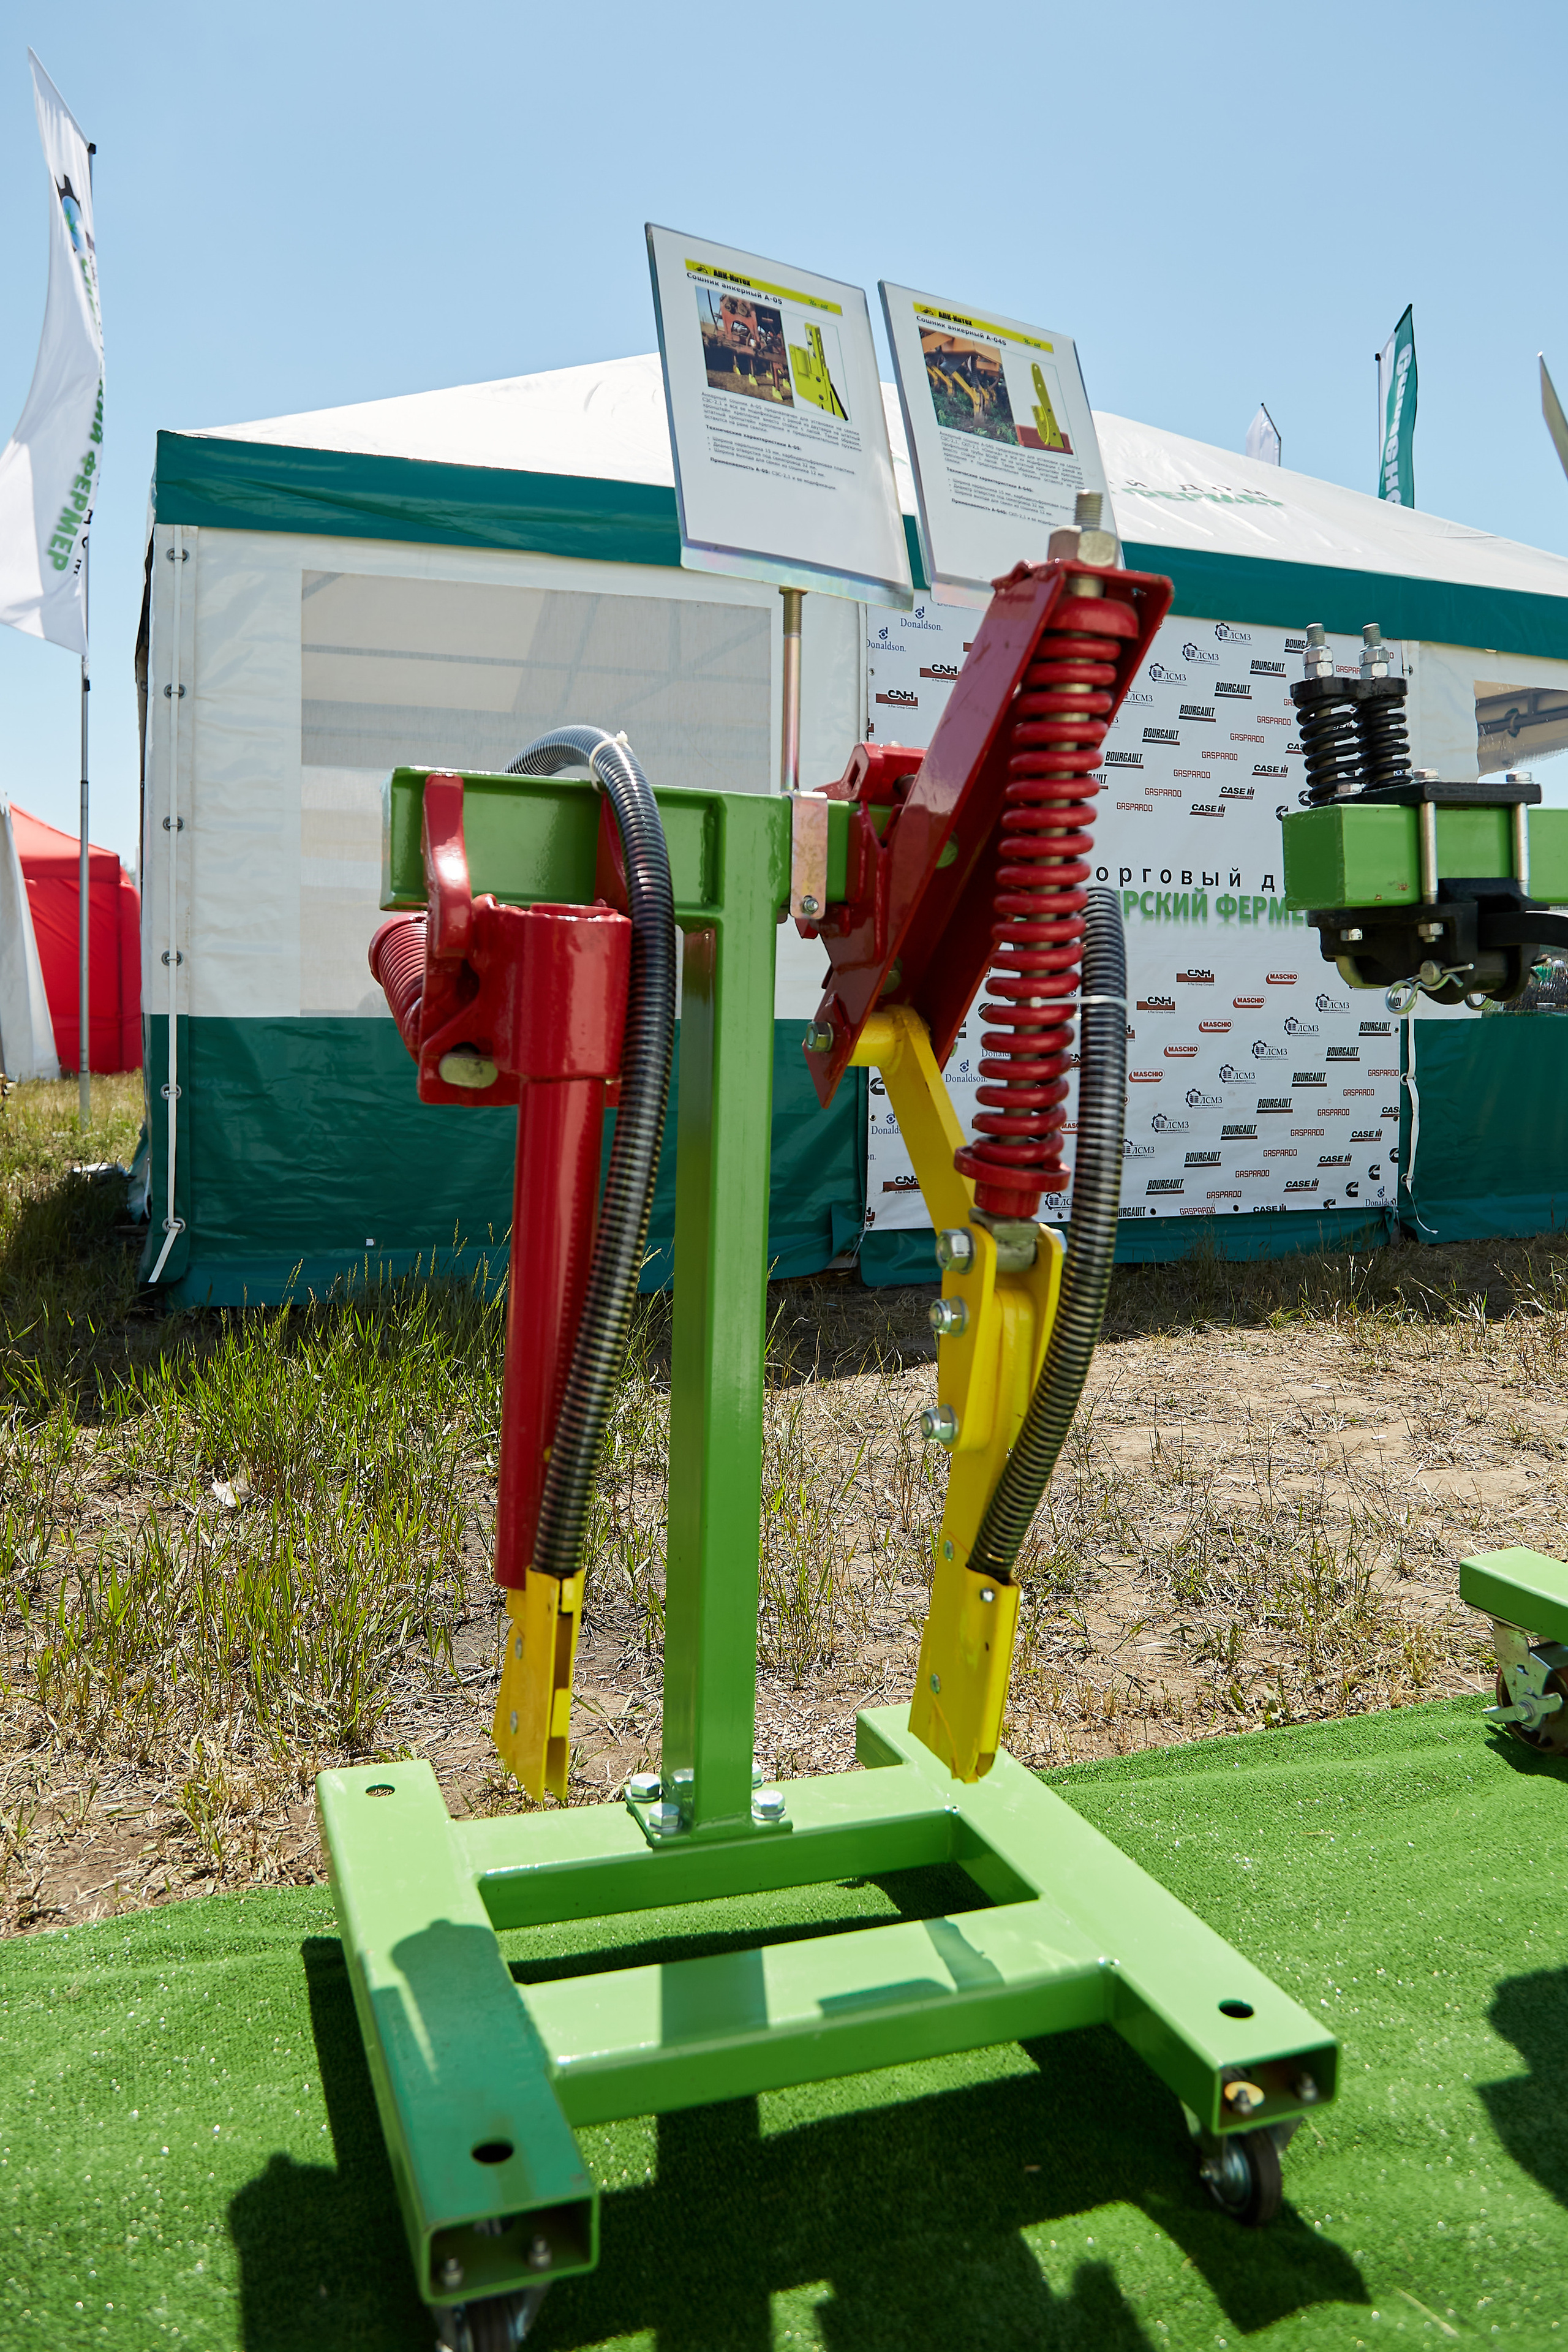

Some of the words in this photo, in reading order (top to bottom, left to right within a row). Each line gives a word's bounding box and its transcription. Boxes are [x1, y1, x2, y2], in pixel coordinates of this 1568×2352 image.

[687, 272, 720, 286] Сошник
[722, 283, 762, 299] анкерный
[764, 295, 783, 304] А-05
[916, 315, 946, 328] Сошник
[948, 325, 984, 339] анкерный
[47, 451, 96, 571] ФЕРМЕР
[932, 664, 958, 674] CNH
[1251, 660, 1285, 673] BOURGAULT
[1215, 682, 1251, 695] BOURGAULT
[888, 690, 914, 700] CNH
[1180, 704, 1215, 717] BOURGAULT
[1257, 715, 1291, 726] GASPARDO
[1143, 727, 1180, 740] BOURGAULT
[1230, 733, 1265, 743] GASPARDO
[1106, 751, 1143, 763] BOURGAULT
[1202, 751, 1238, 761] GASPARDO
[1174, 769, 1211, 778] GASPARDO
[1254, 764, 1279, 773] CASE
[1145, 788, 1182, 797] GASPARDO
[1221, 786, 1246, 795] CASE
[1117, 802, 1153, 812] GASPARDO
[1191, 804, 1217, 812] CASE
[1095, 865, 1241, 888] орговый
[1360, 1022, 1391, 1031] BOURGAULT
[1327, 1047, 1359, 1057] BOURGAULT
[1292, 1072, 1327, 1082] BOURGAULT
[1257, 1098, 1292, 1108] BOURGAULT
[1221, 1125, 1257, 1134] BOURGAULT
[1185, 1152, 1221, 1163] BOURGAULT
[1147, 1178, 1184, 1190] BOURGAULT
[1180, 1207, 1216, 1215] GASPARDO
